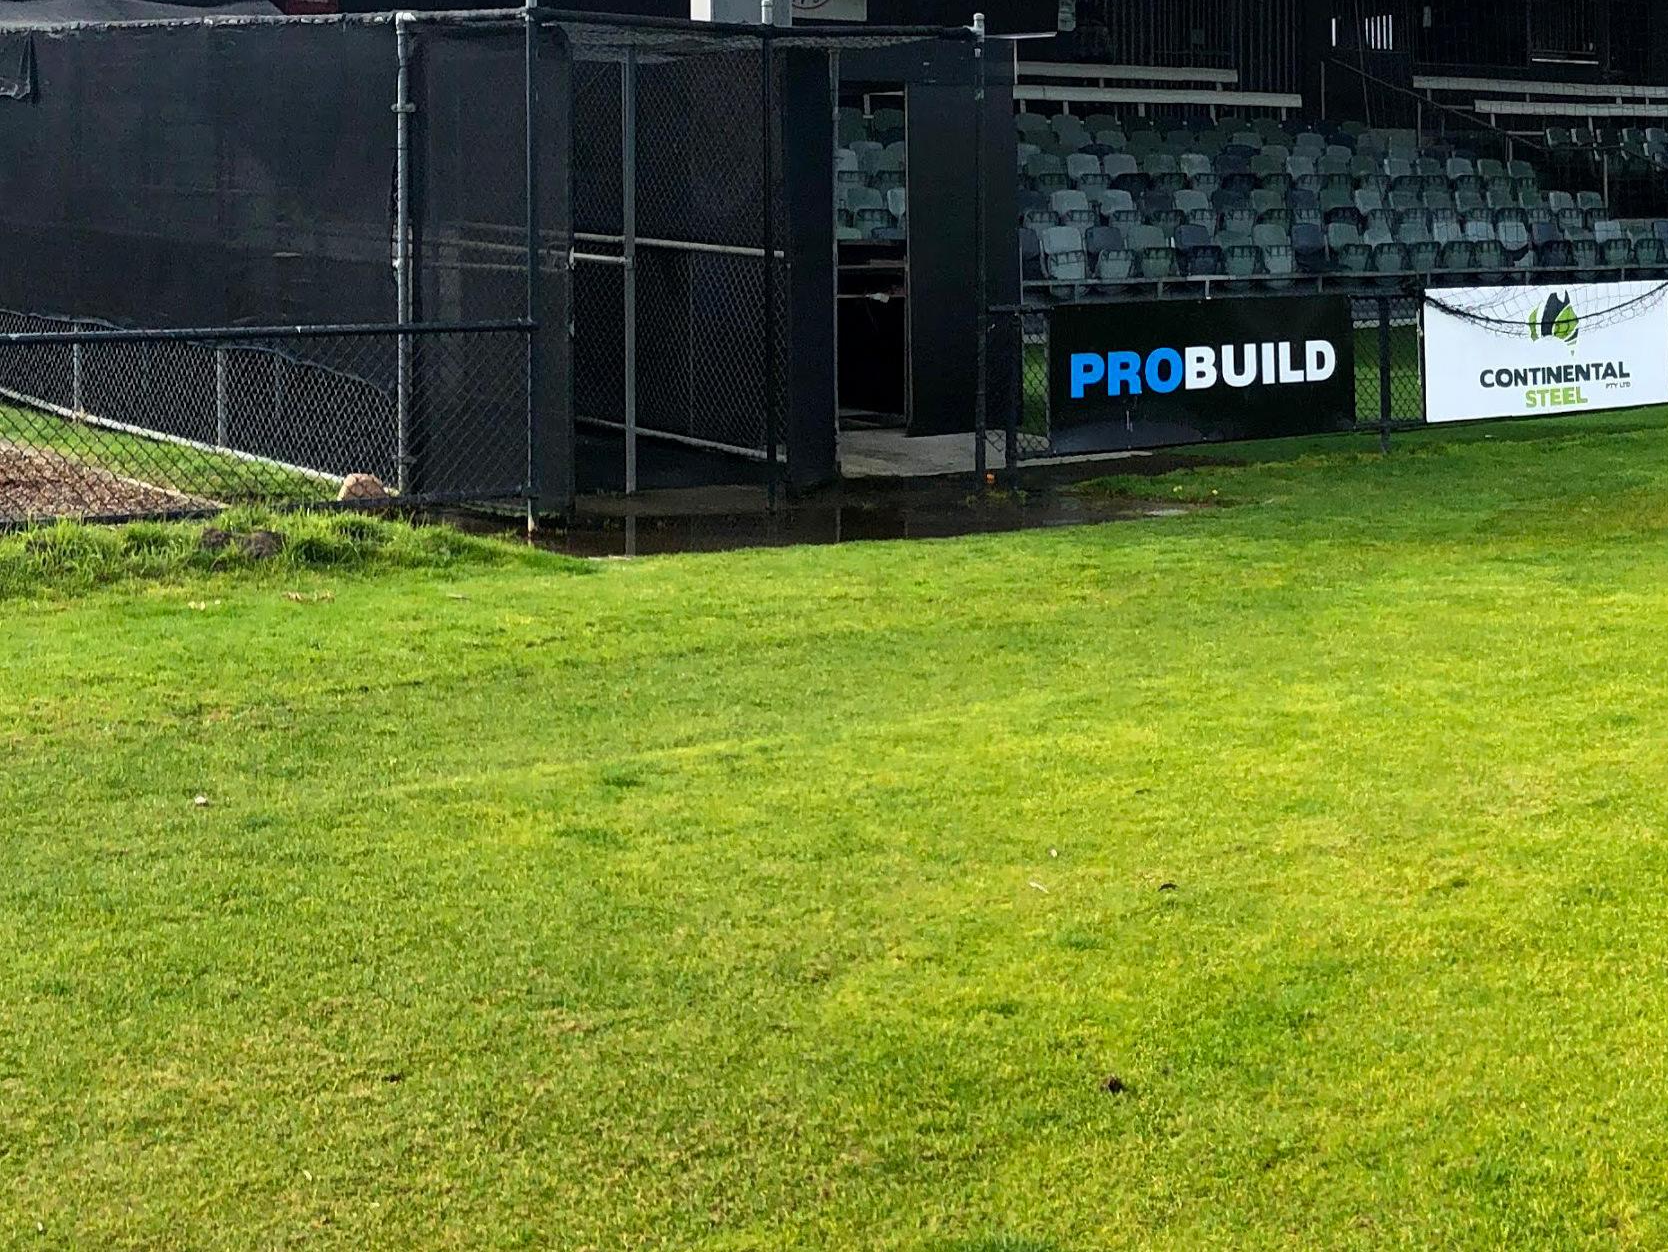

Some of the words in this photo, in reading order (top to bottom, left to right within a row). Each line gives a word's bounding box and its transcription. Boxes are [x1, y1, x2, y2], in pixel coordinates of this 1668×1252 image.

[1070, 339, 1337, 399] PROBUILD
[1479, 361, 1631, 388] CONTINENTAL
[1525, 386, 1589, 408] STEEL
